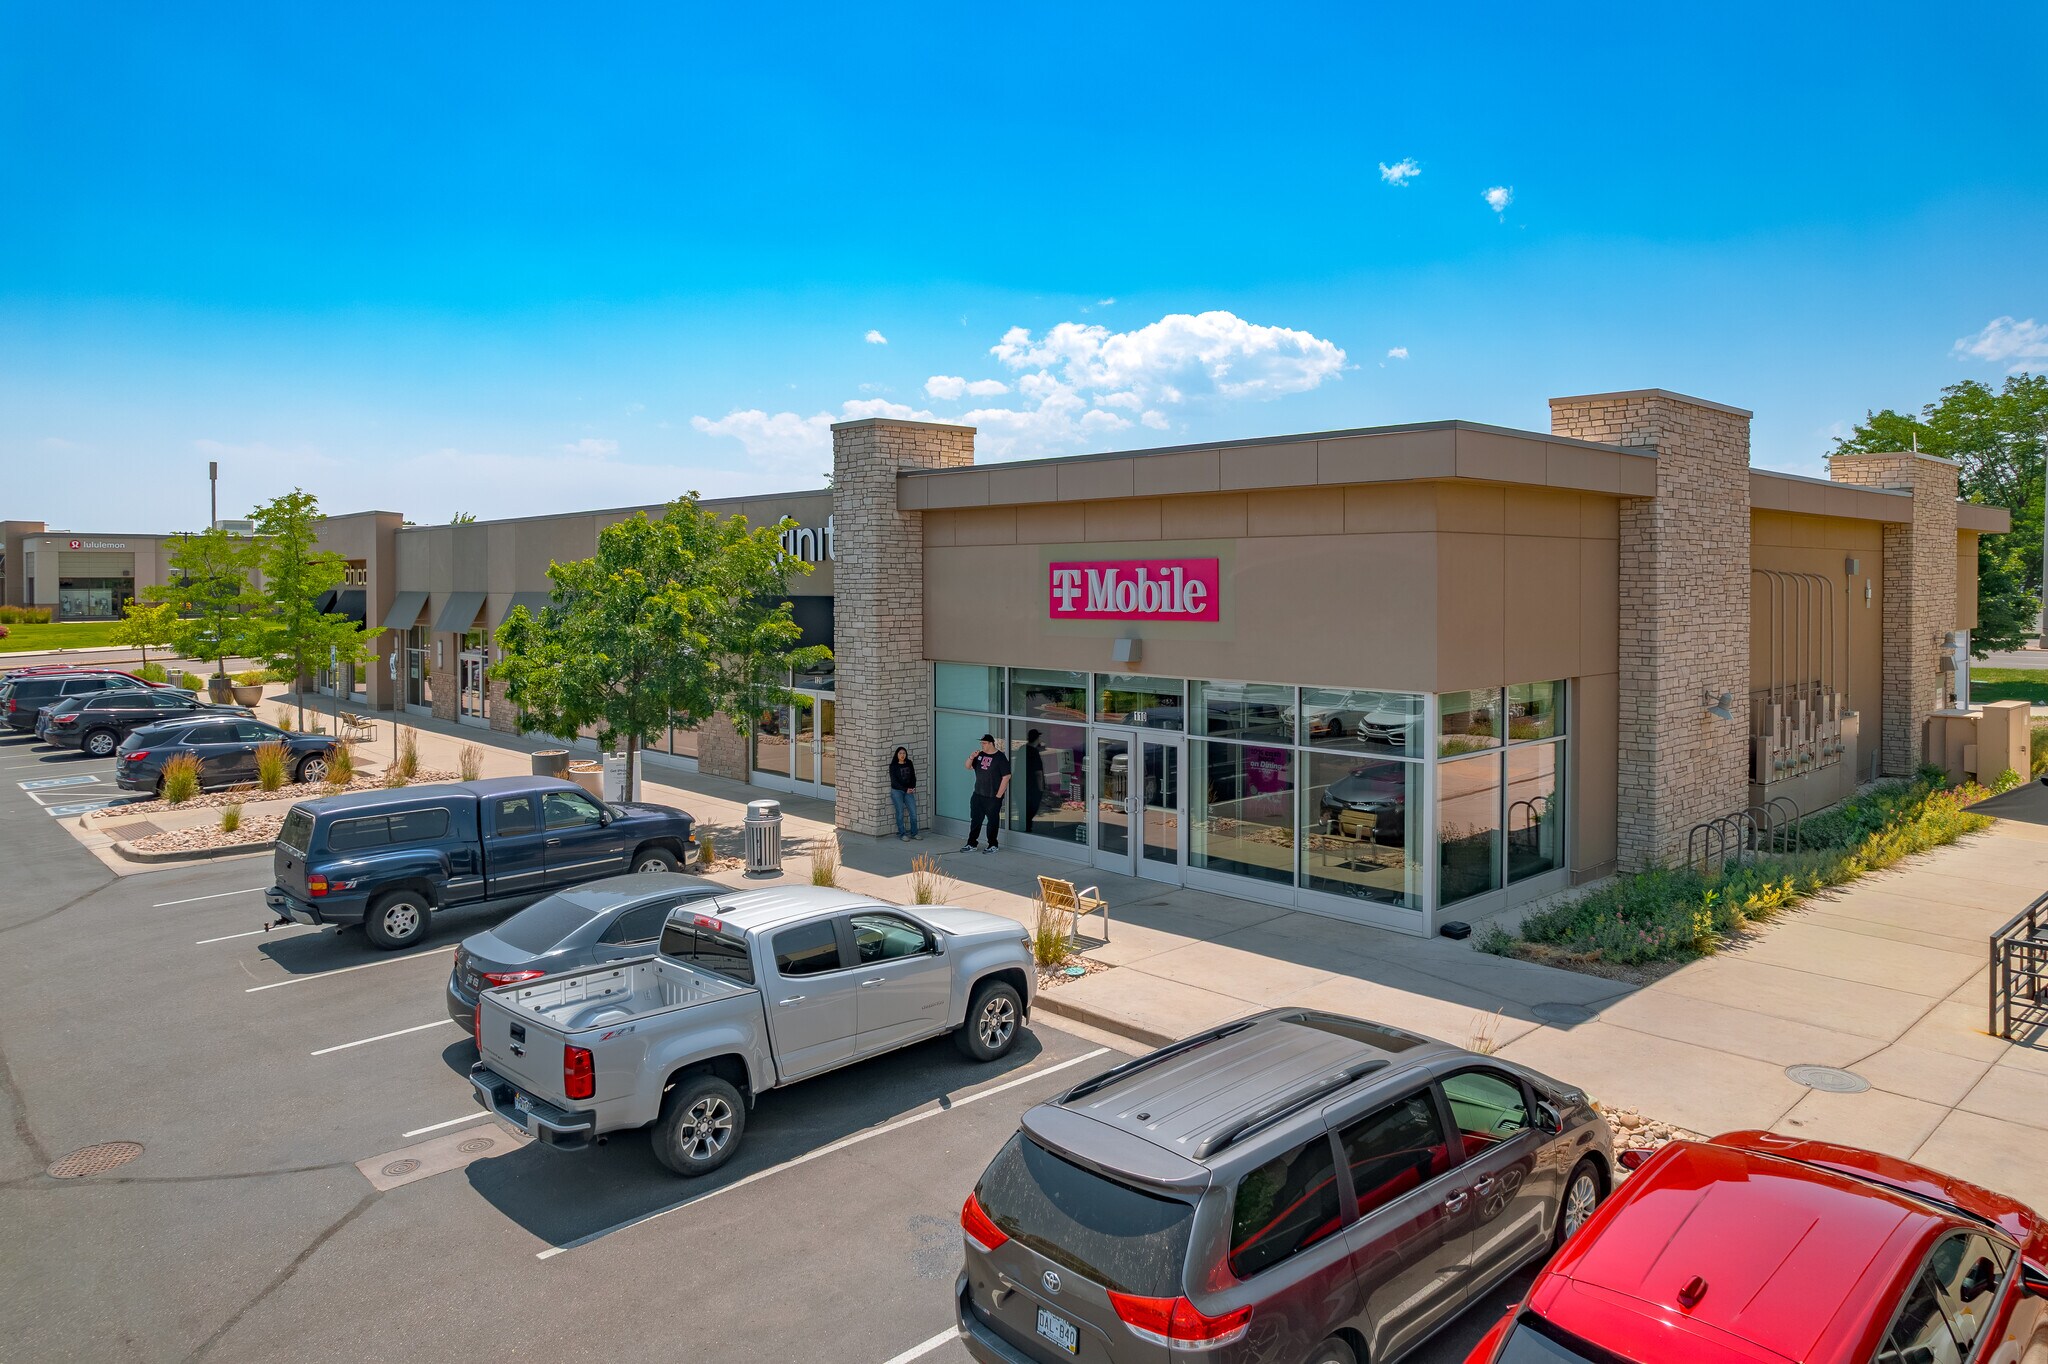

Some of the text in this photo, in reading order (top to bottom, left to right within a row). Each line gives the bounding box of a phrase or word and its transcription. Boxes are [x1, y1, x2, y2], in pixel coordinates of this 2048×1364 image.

[776, 514, 836, 563] finit
[83, 541, 125, 549] lululemon
[1085, 567, 1208, 614] Mobile
[1133, 711, 1147, 722] 110
[1260, 761, 1282, 771] Dining
